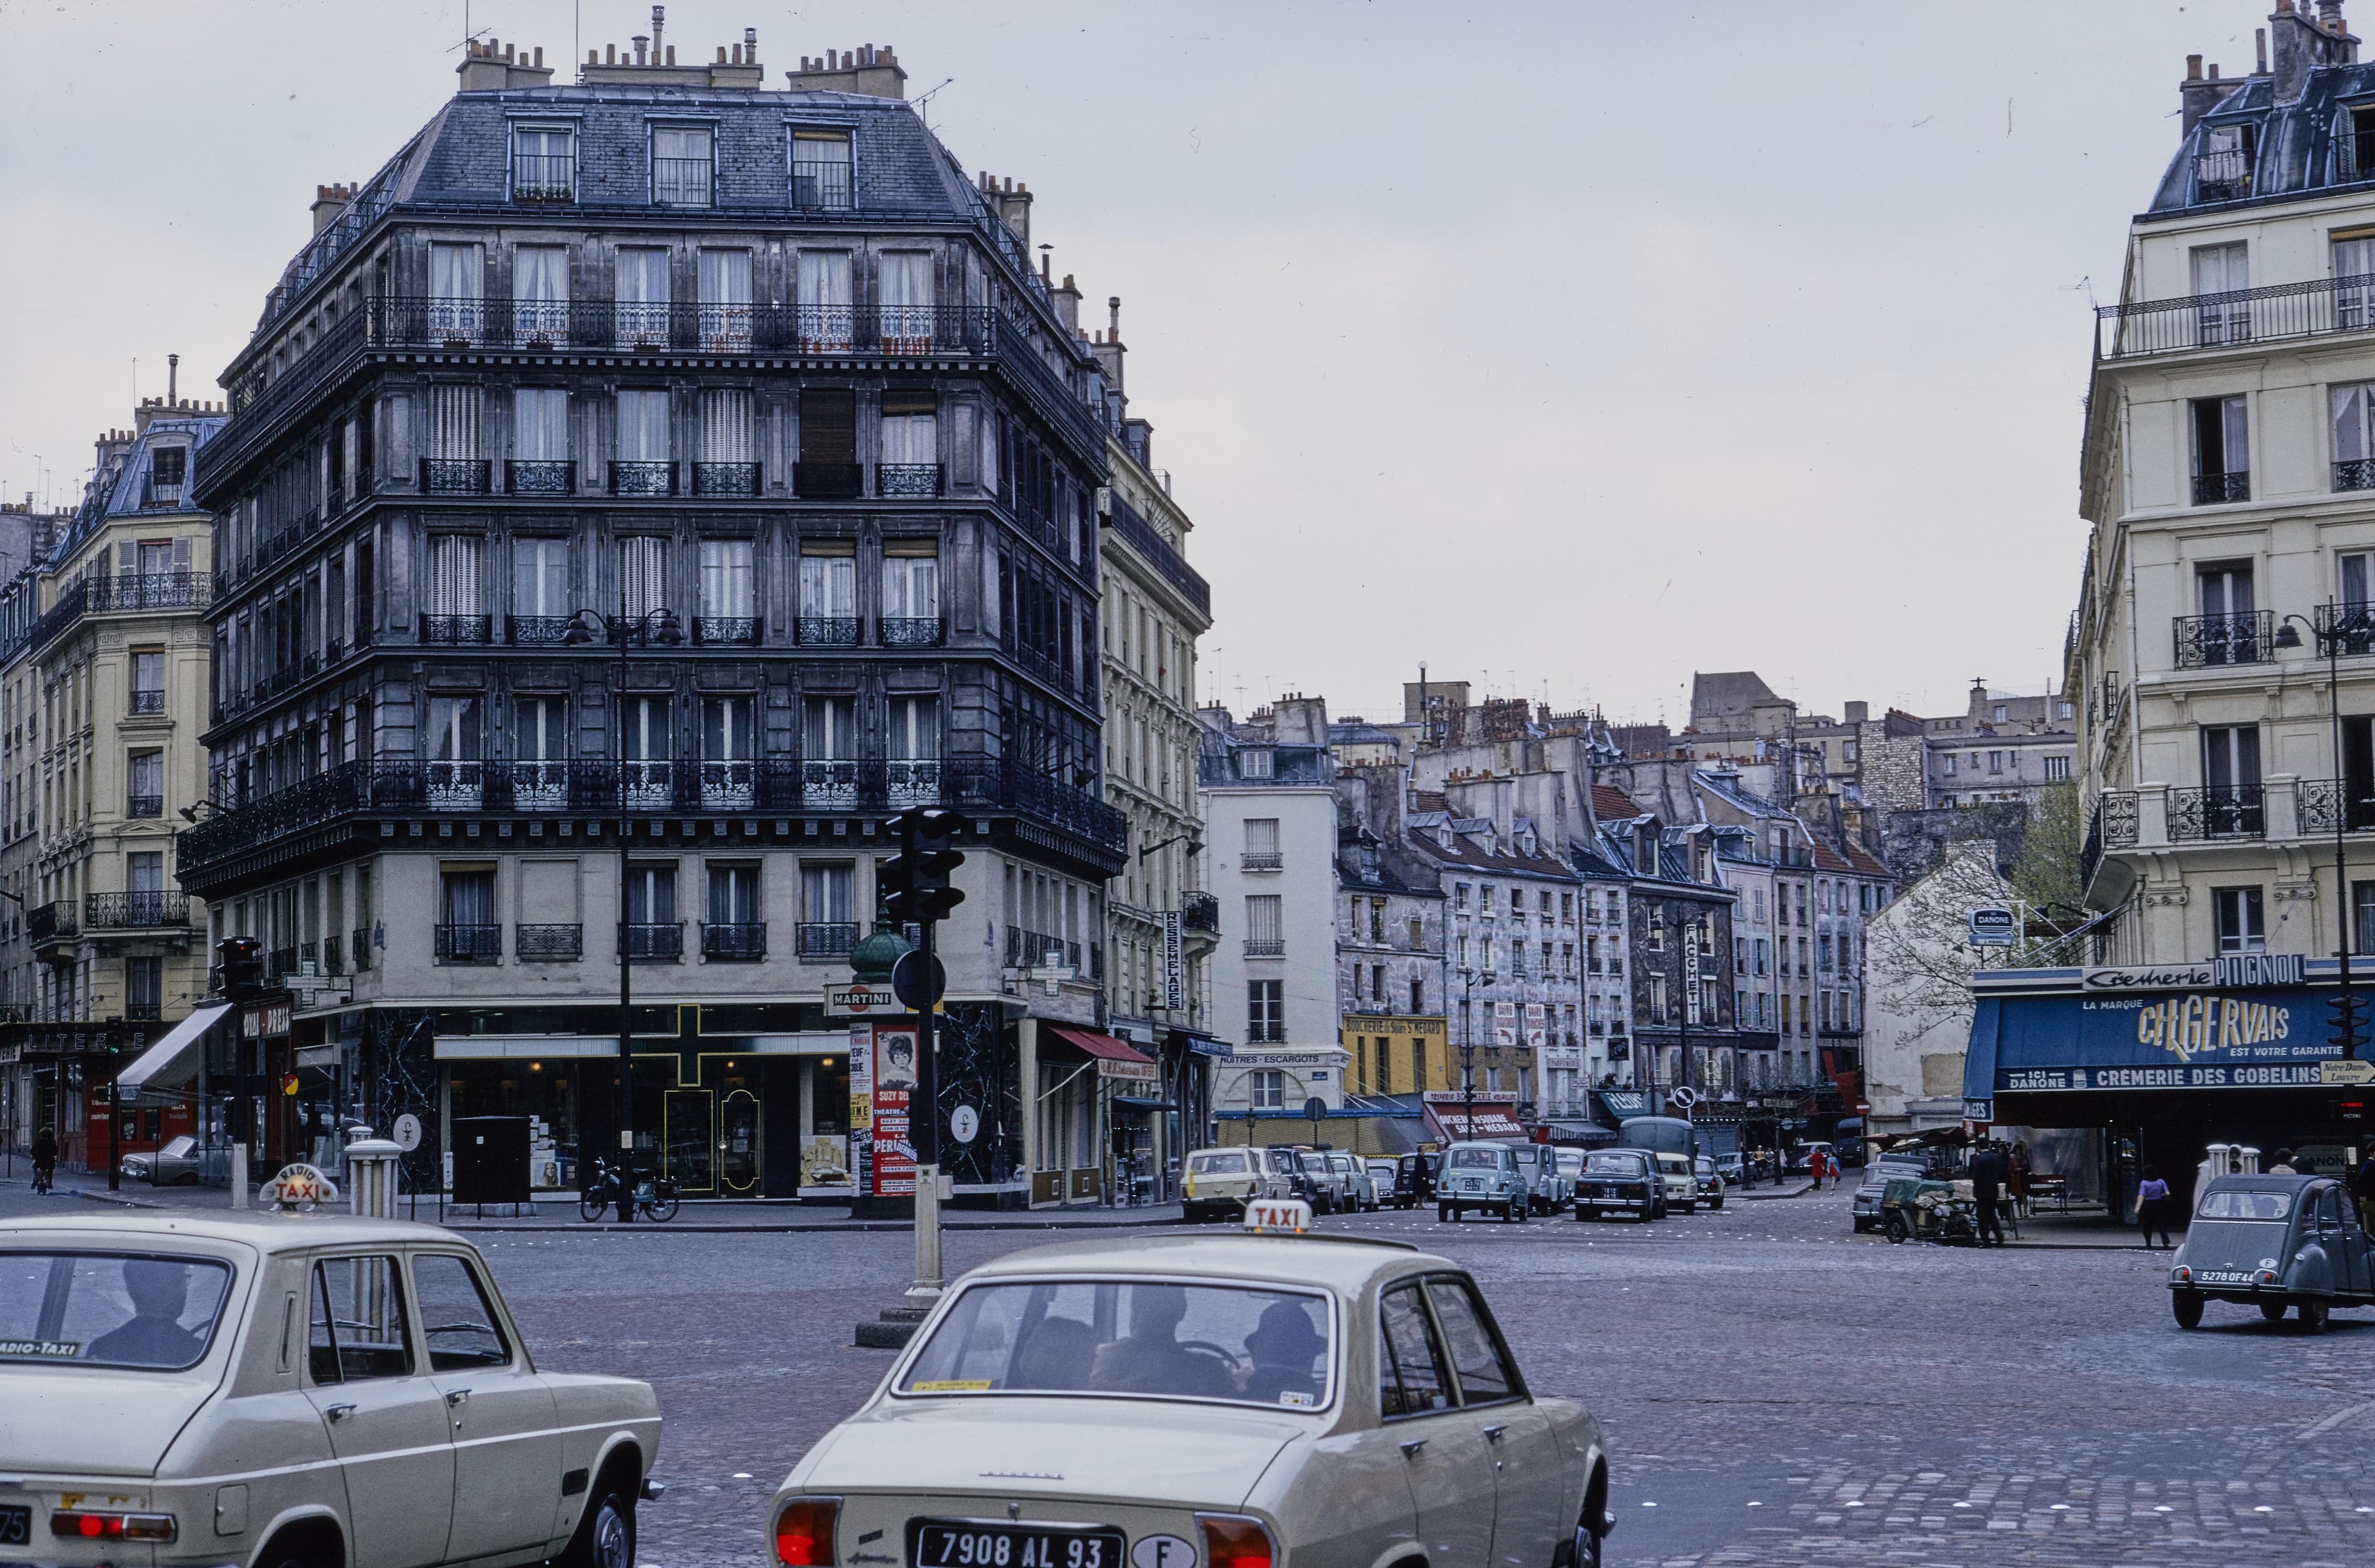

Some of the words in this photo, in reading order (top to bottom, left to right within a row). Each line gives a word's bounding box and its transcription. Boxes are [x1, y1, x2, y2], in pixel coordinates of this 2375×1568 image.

[1166, 913, 1179, 1008] RESSEMELAGES
[1686, 926, 1698, 1024] FACCHETTI
[2215, 956, 2303, 986] PIGNOL
[834, 994, 889, 1004] MARTINI
[2082, 1001, 2096, 1010] LA
[2100, 999, 2144, 1010] MARQUE
[267, 1007, 289, 1034] PRESS
[1346, 1020, 1384, 1033] BOUCHERIE
[28, 1033, 144, 1050] LITERE
[1264, 1055, 1319, 1063] ESCARGOTS
[2230, 1047, 2248, 1057] EST
[2254, 1047, 2287, 1056] VOTRE
[2292, 1046, 2343, 1055] GARANTIE
[2324, 1063, 2345, 1072] Notre
[2345, 1063, 2366, 1072] Dame
[2009, 1078, 2066, 1089] DANONE
[2193, 1068, 2226, 1085] DES
[2233, 1067, 2321, 1084] GOBELINS
[2330, 1073, 2361, 1081] Louvre
[879, 1091, 896, 1101] SUZY
[1480, 1114, 1508, 1124] SQUARE
[280, 1165, 315, 1181] RADIO
[275, 1183, 319, 1198] TAXI
[1256, 1208, 1299, 1226] TAXI
[0, 1511, 25, 1541] 75
[940, 1533, 1011, 1566] 7908
[1022, 1536, 1053, 1568] AL
[1068, 1539, 1102, 1568] 93
[1157, 1540, 1171, 1568] F
